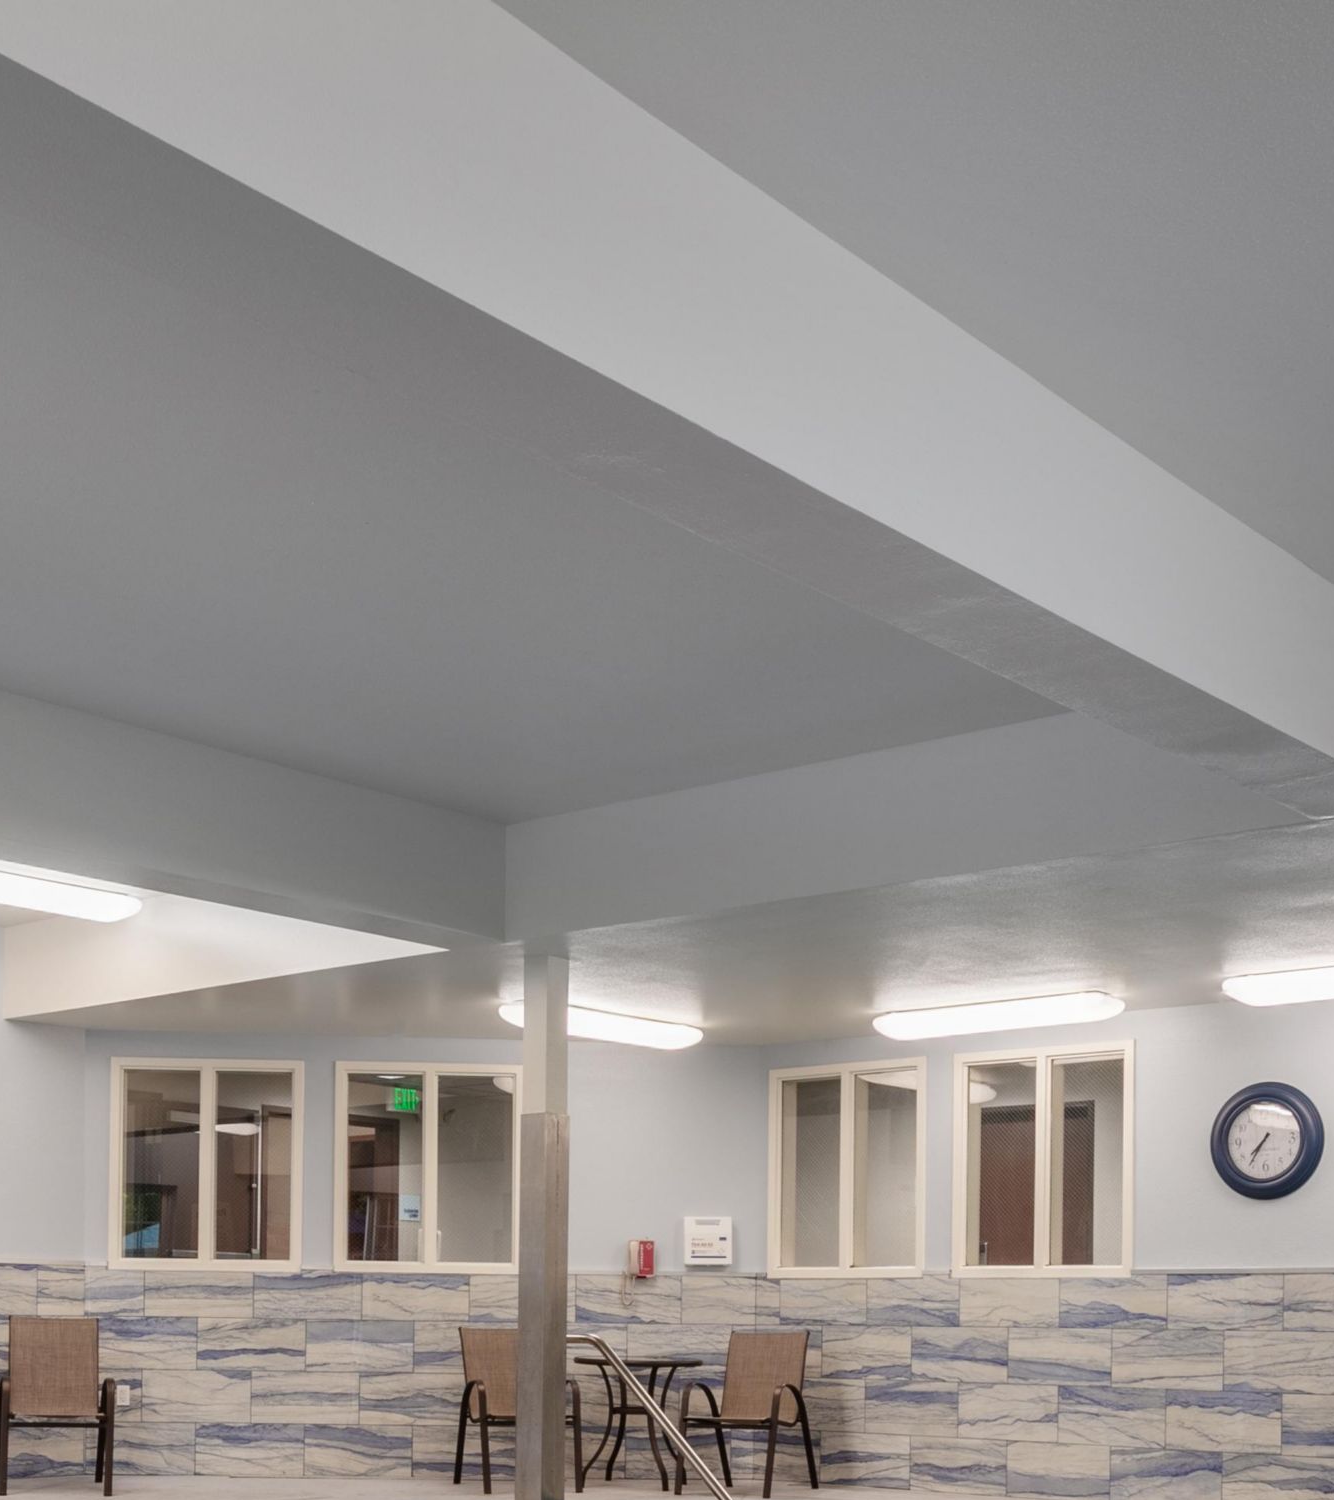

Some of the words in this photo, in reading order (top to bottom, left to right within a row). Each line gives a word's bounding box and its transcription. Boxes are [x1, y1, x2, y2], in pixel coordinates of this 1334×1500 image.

[394, 1087, 417, 1111] EXIT
[1234, 1137, 1242, 1149] 9
[1288, 1131, 1296, 1144] 3
[1262, 1159, 1270, 1172] 6
